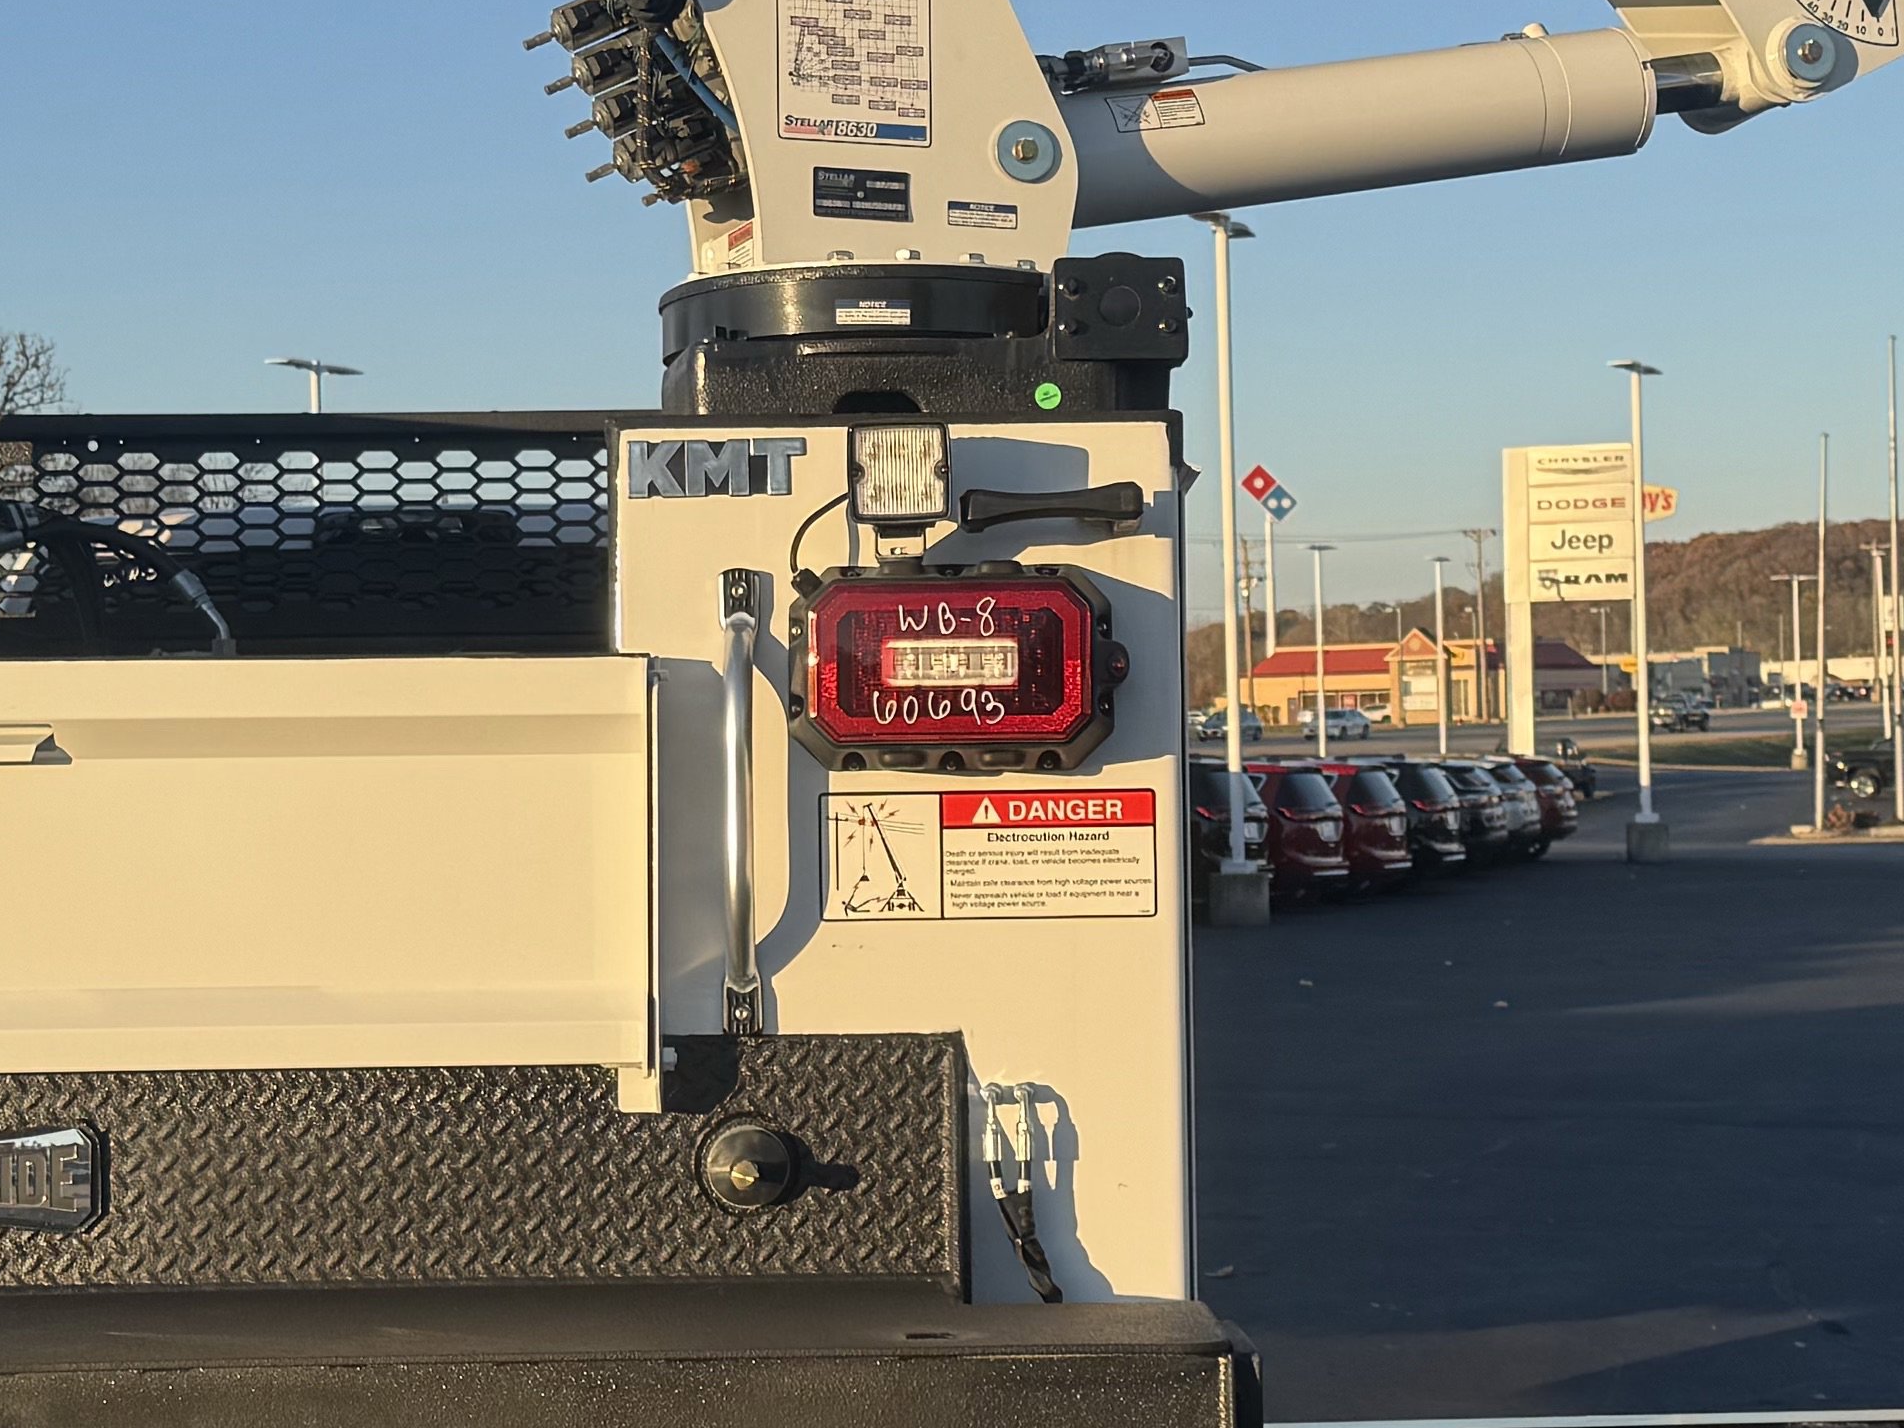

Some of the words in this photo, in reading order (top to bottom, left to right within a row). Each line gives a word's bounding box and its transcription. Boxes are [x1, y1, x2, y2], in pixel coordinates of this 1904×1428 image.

[1807, 1, 1819, 13] 40
[1856, 26, 1867, 35] 10
[1877, 27, 1884, 36] 0
[784, 115, 834, 128] STELLAR
[836, 122, 878, 137] 8630
[1537, 455, 1625, 465] CHRYSLER
[627, 437, 807, 499] KMT
[1537, 497, 1626, 511] DODGE
[1550, 529, 1614, 554] Jeep
[1563, 573, 1629, 585] RAM
[873, 688, 1006, 726] 60693
[1007, 799, 1124, 822] DANGER
[987, 832, 1065, 843] Electrocution
[1069, 830, 1110, 842] Hazard
